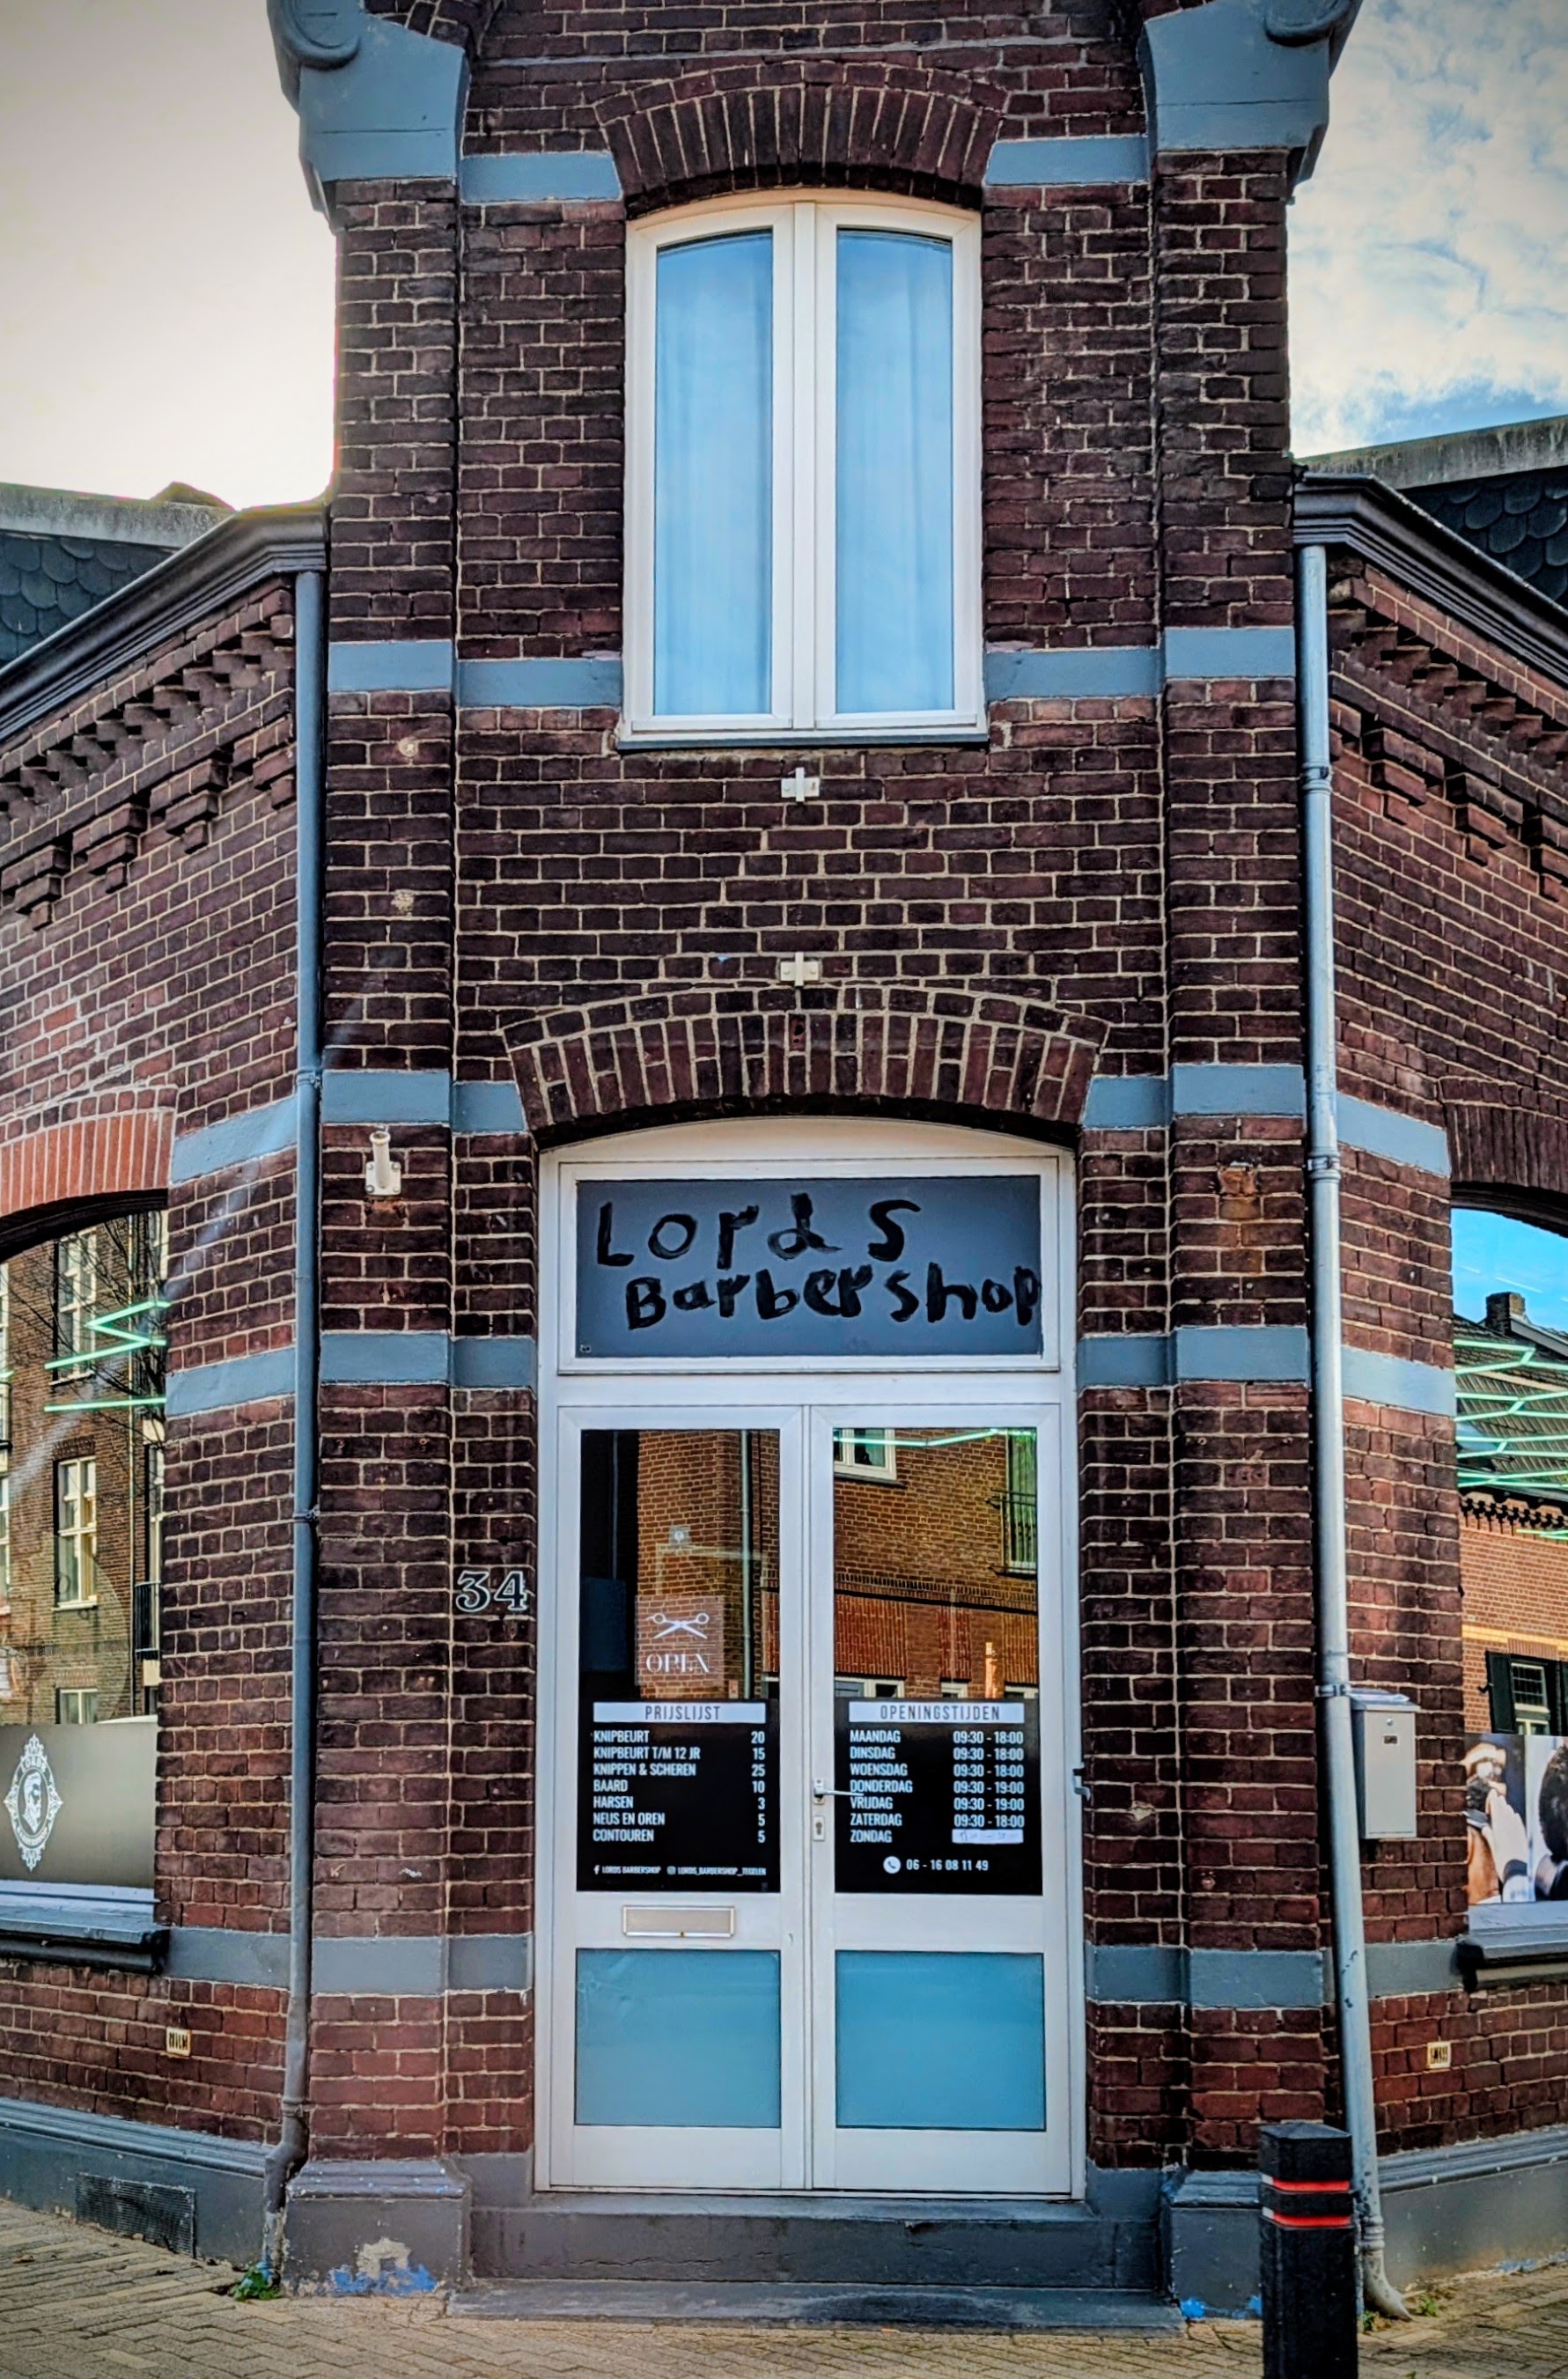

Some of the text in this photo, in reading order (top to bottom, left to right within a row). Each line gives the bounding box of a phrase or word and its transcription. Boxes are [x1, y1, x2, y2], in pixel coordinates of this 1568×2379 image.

[597, 1193, 921, 1270] Lords
[625, 1262, 1042, 1329] Barbershop
[455, 1570, 528, 1613] 34
[645, 1654, 710, 1673] OPEN
[644, 1705, 720, 1720] PRIJSLIJST
[880, 1705, 1000, 1720] OPENINGSTIJDEN
[593, 1730, 765, 1743] KNIPBEURT 20
[850, 1730, 901, 1742] MAANDAG
[953, 1731, 983, 1743] 09:30
[994, 1731, 1024, 1744] 18:00
[593, 1747, 765, 1760] KNIPBEURT T/M 12 JR 15
[850, 1747, 895, 1759] DINSDAG
[953, 1748, 983, 1760] 09:30
[994, 1748, 1024, 1761] 18:00
[593, 1763, 765, 1777] KNIPPEN & SCHEREN 25
[850, 1764, 908, 1776] WOENSDAG
[953, 1764, 983, 1777] 09:30
[995, 1764, 1024, 1778] 18:00
[593, 1779, 765, 1793] BAARD 10
[850, 1779, 913, 1793] DONDERDAG
[953, 1781, 984, 1793] 09:30
[995, 1781, 1024, 1794] 19:00
[593, 1796, 765, 1809] HARSEN 3
[850, 1796, 893, 1809] VRIJDAG
[953, 1798, 984, 1810] 09:30
[995, 1798, 1024, 1811] 19:00
[593, 1813, 765, 1826] NEUS EN OREN 5
[850, 1813, 902, 1826] ZATERDAG
[954, 1815, 984, 1827] 09:30
[995, 1815, 1024, 1828] 18:00
[593, 1829, 765, 1843] CONTOUREN 5
[850, 1830, 892, 1843] ZONDAG
[906, 1860, 919, 1870] 06
[931, 1860, 942, 1870] 16
[946, 1860, 959, 1870] 08
[962, 1860, 972, 1871] 11
[975, 1860, 989, 1871] 49
